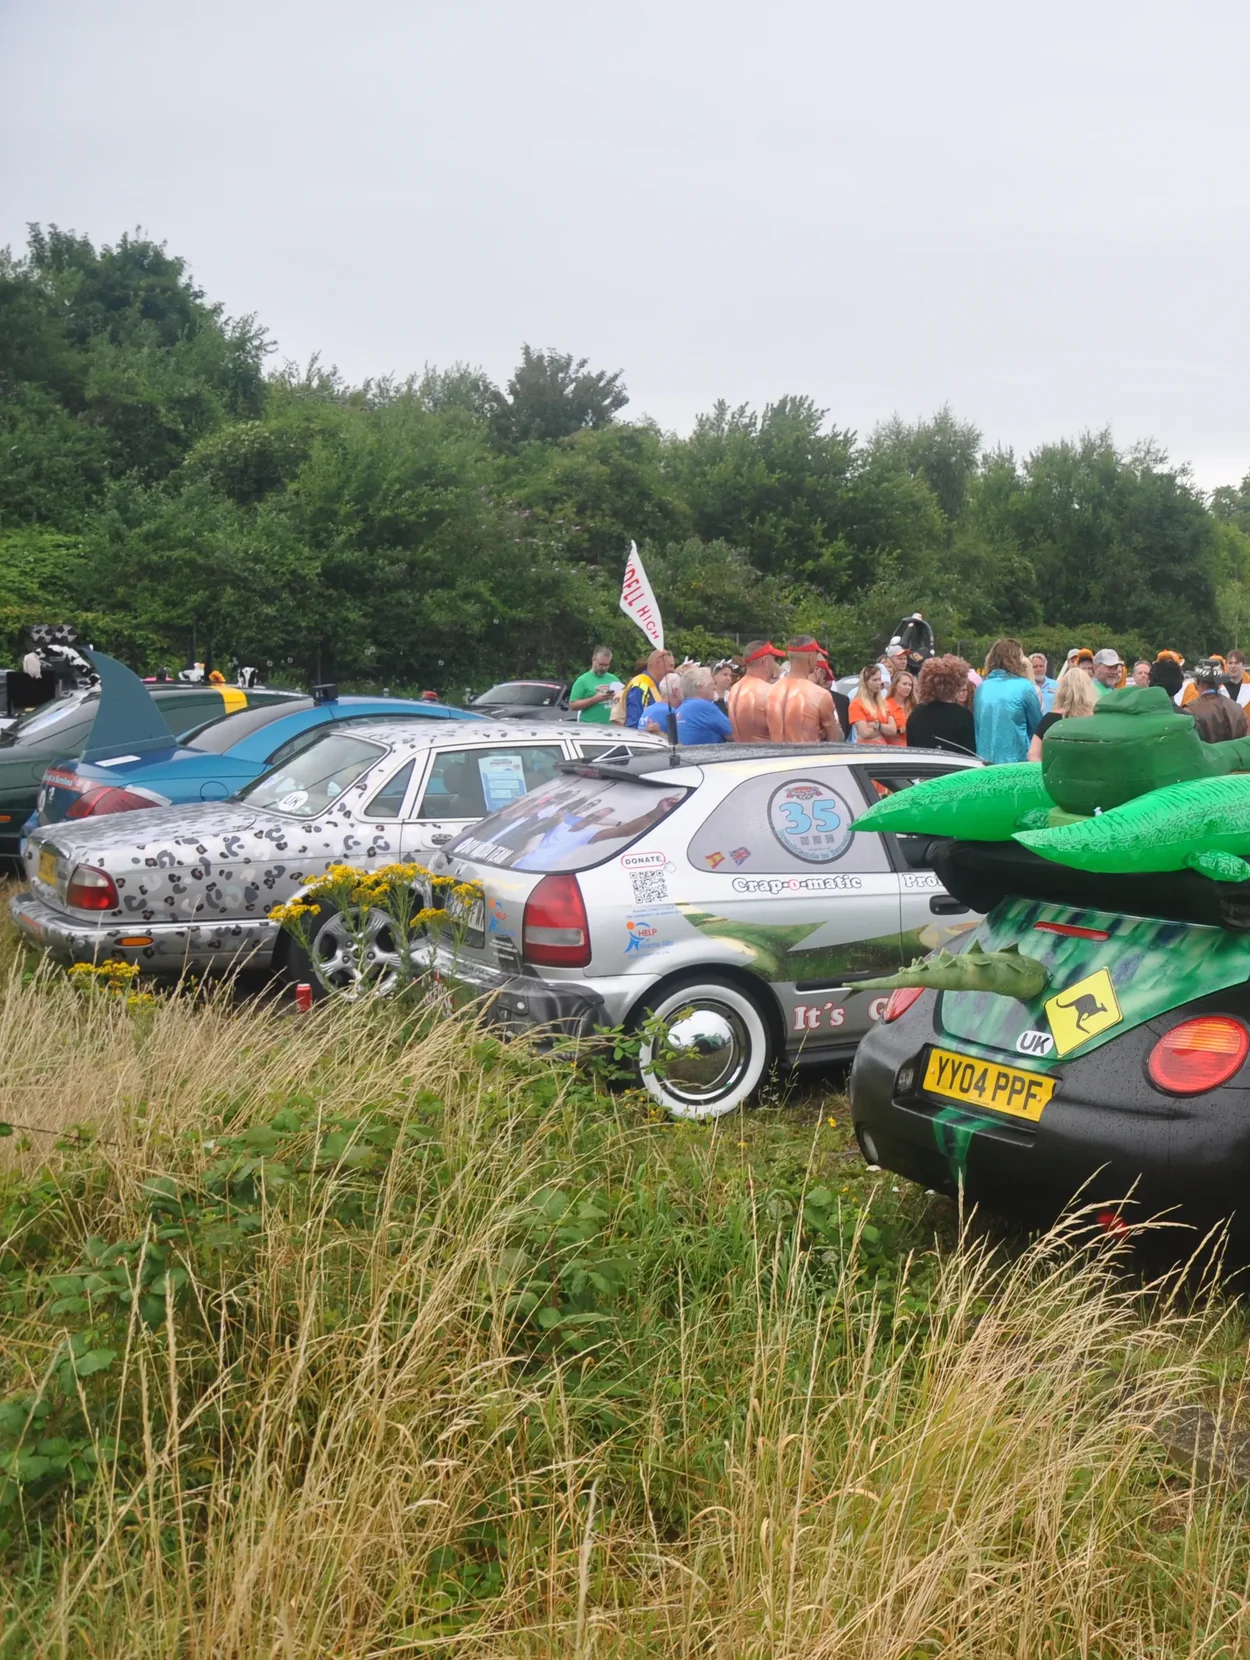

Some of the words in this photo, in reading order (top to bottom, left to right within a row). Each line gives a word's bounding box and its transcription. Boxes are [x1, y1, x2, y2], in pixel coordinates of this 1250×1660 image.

[636, 604, 660, 640] HIGH
[283, 797, 299, 808] UK
[779, 798, 841, 835] 35
[625, 855, 662, 866] DONATE
[732, 875, 862, 894] Crap-o-matic
[637, 928, 658, 937] HELP
[793, 1002, 845, 1031] It's
[1020, 1033, 1050, 1054] UK
[936, 1056, 989, 1098] YY04
[990, 1071, 1043, 1110] PPF
